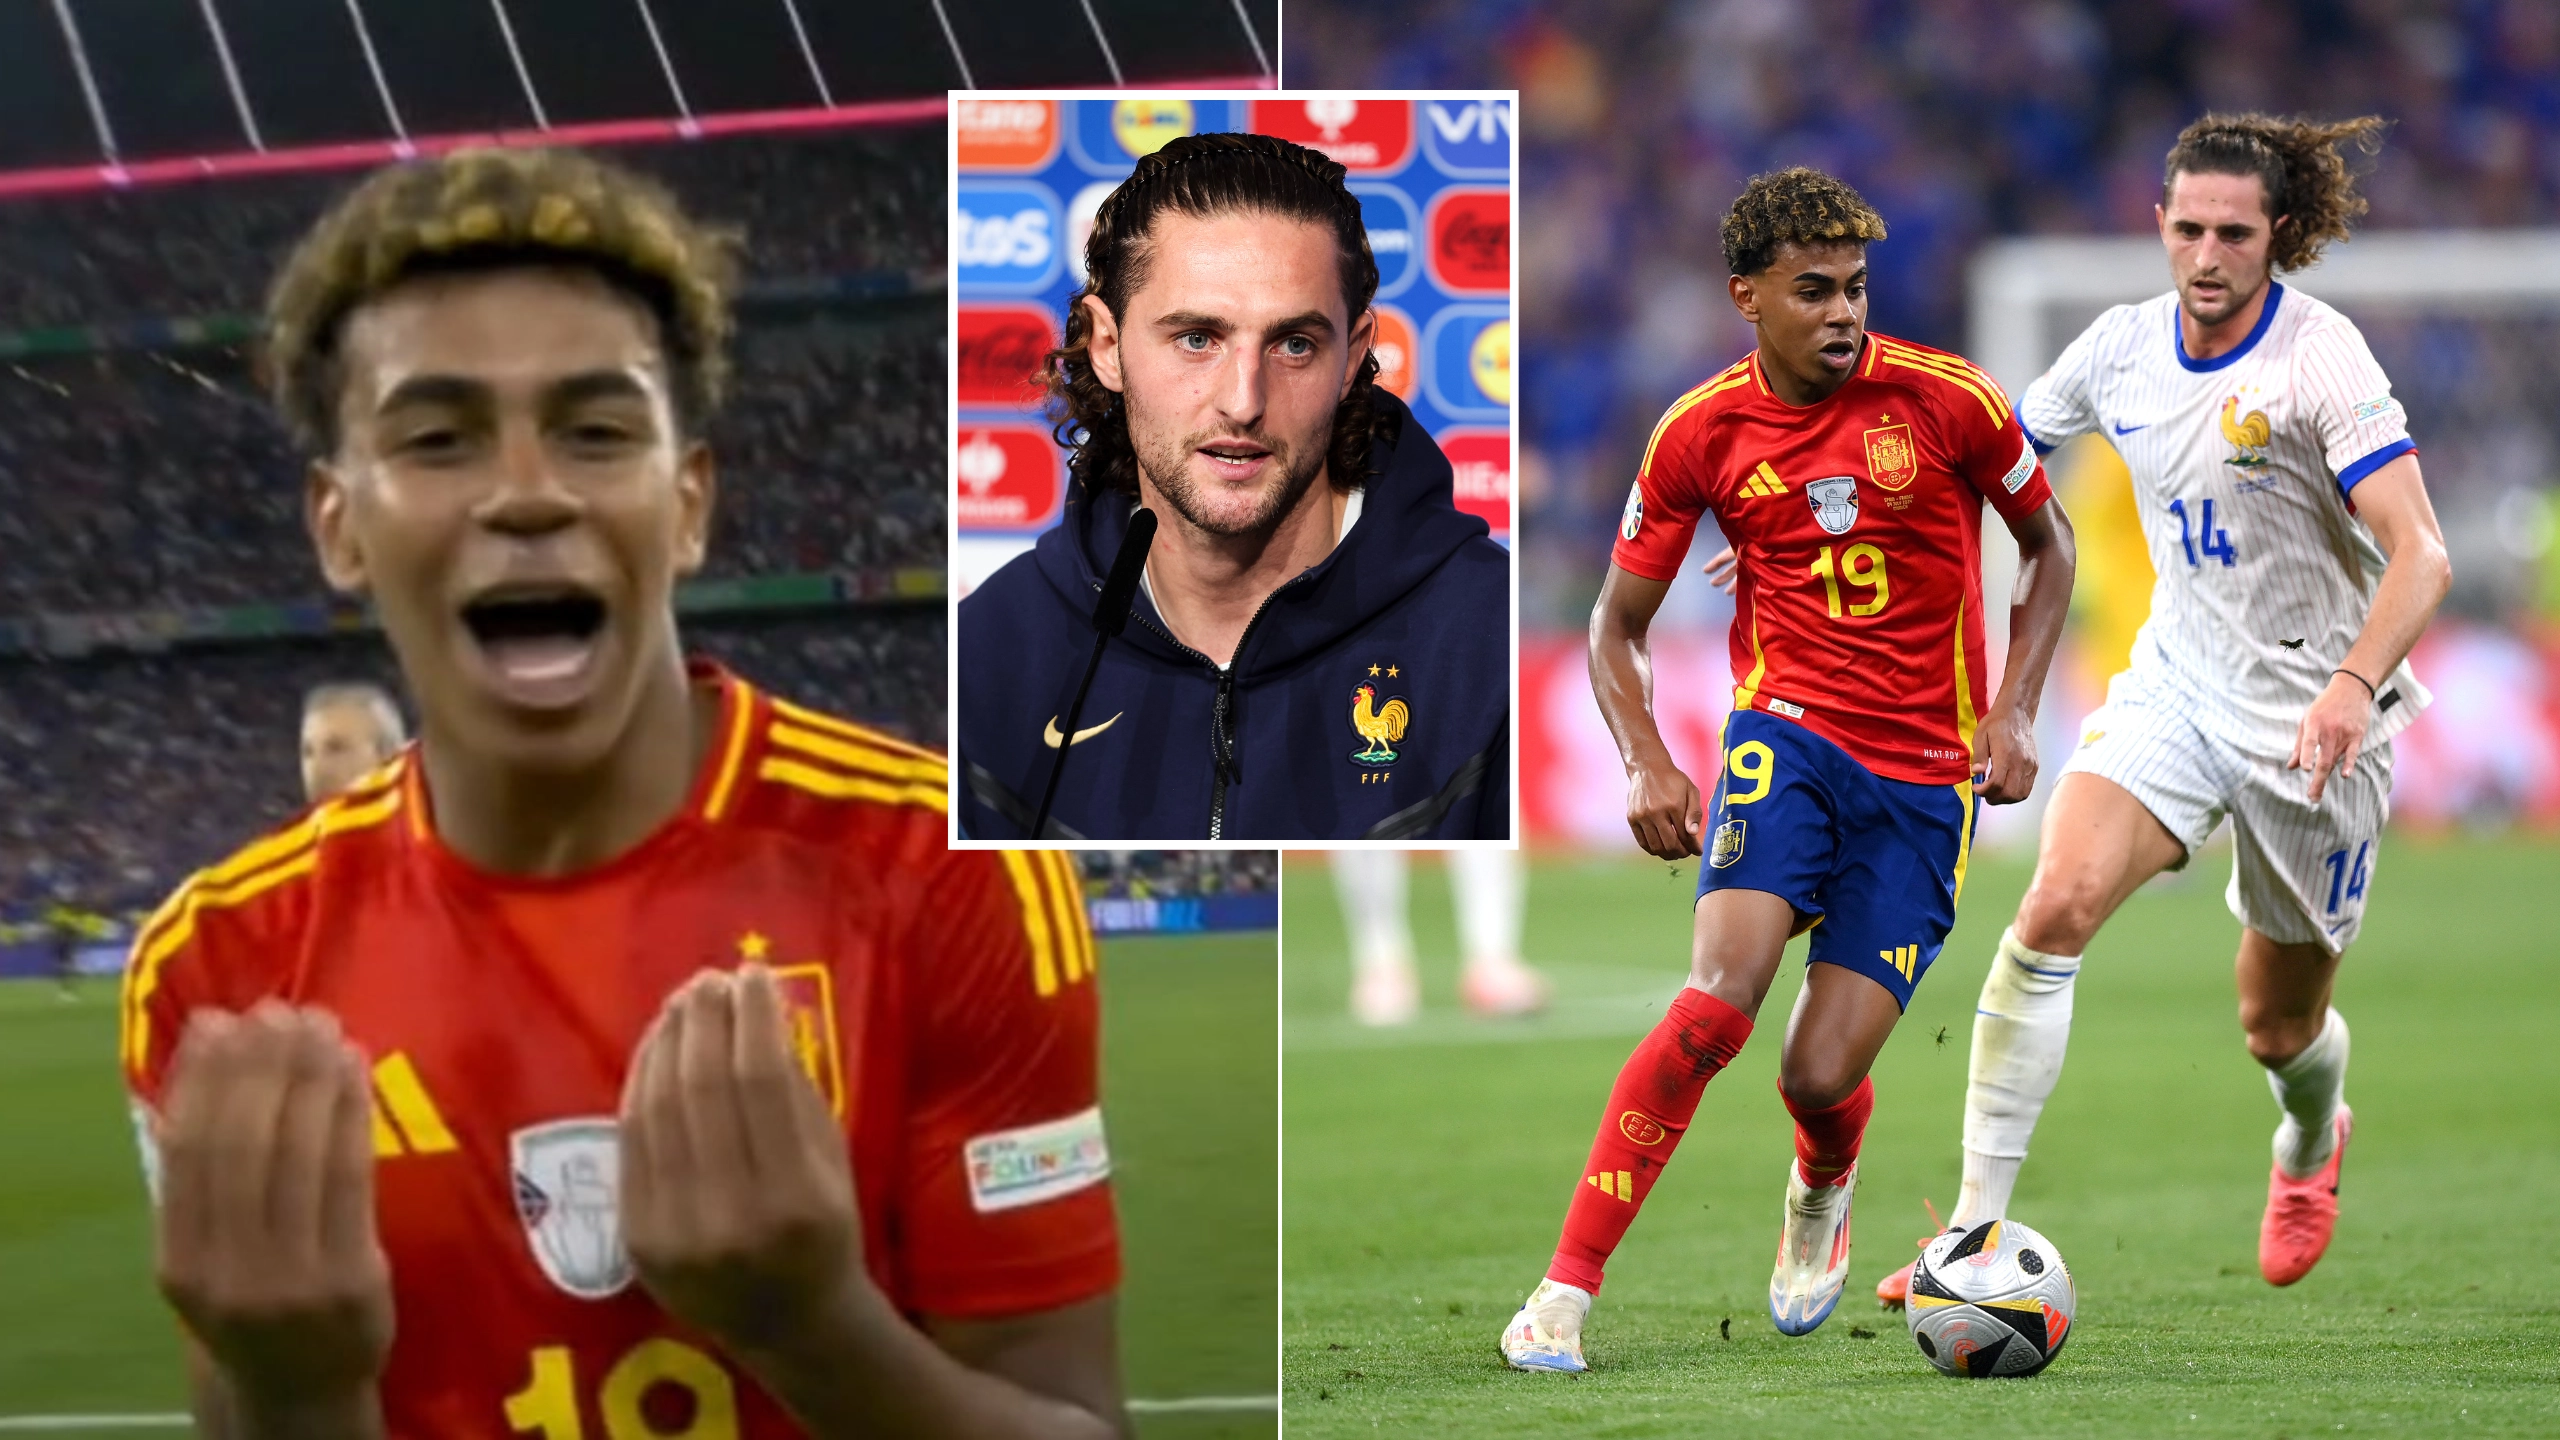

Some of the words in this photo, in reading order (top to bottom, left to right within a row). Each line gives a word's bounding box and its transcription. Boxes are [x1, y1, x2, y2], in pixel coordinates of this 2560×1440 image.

[2169, 498, 2238, 569] 14
[1810, 543, 1890, 619] 19
[1923, 748, 1959, 760] HEAT.RDY
[2325, 838, 2370, 915] 14
